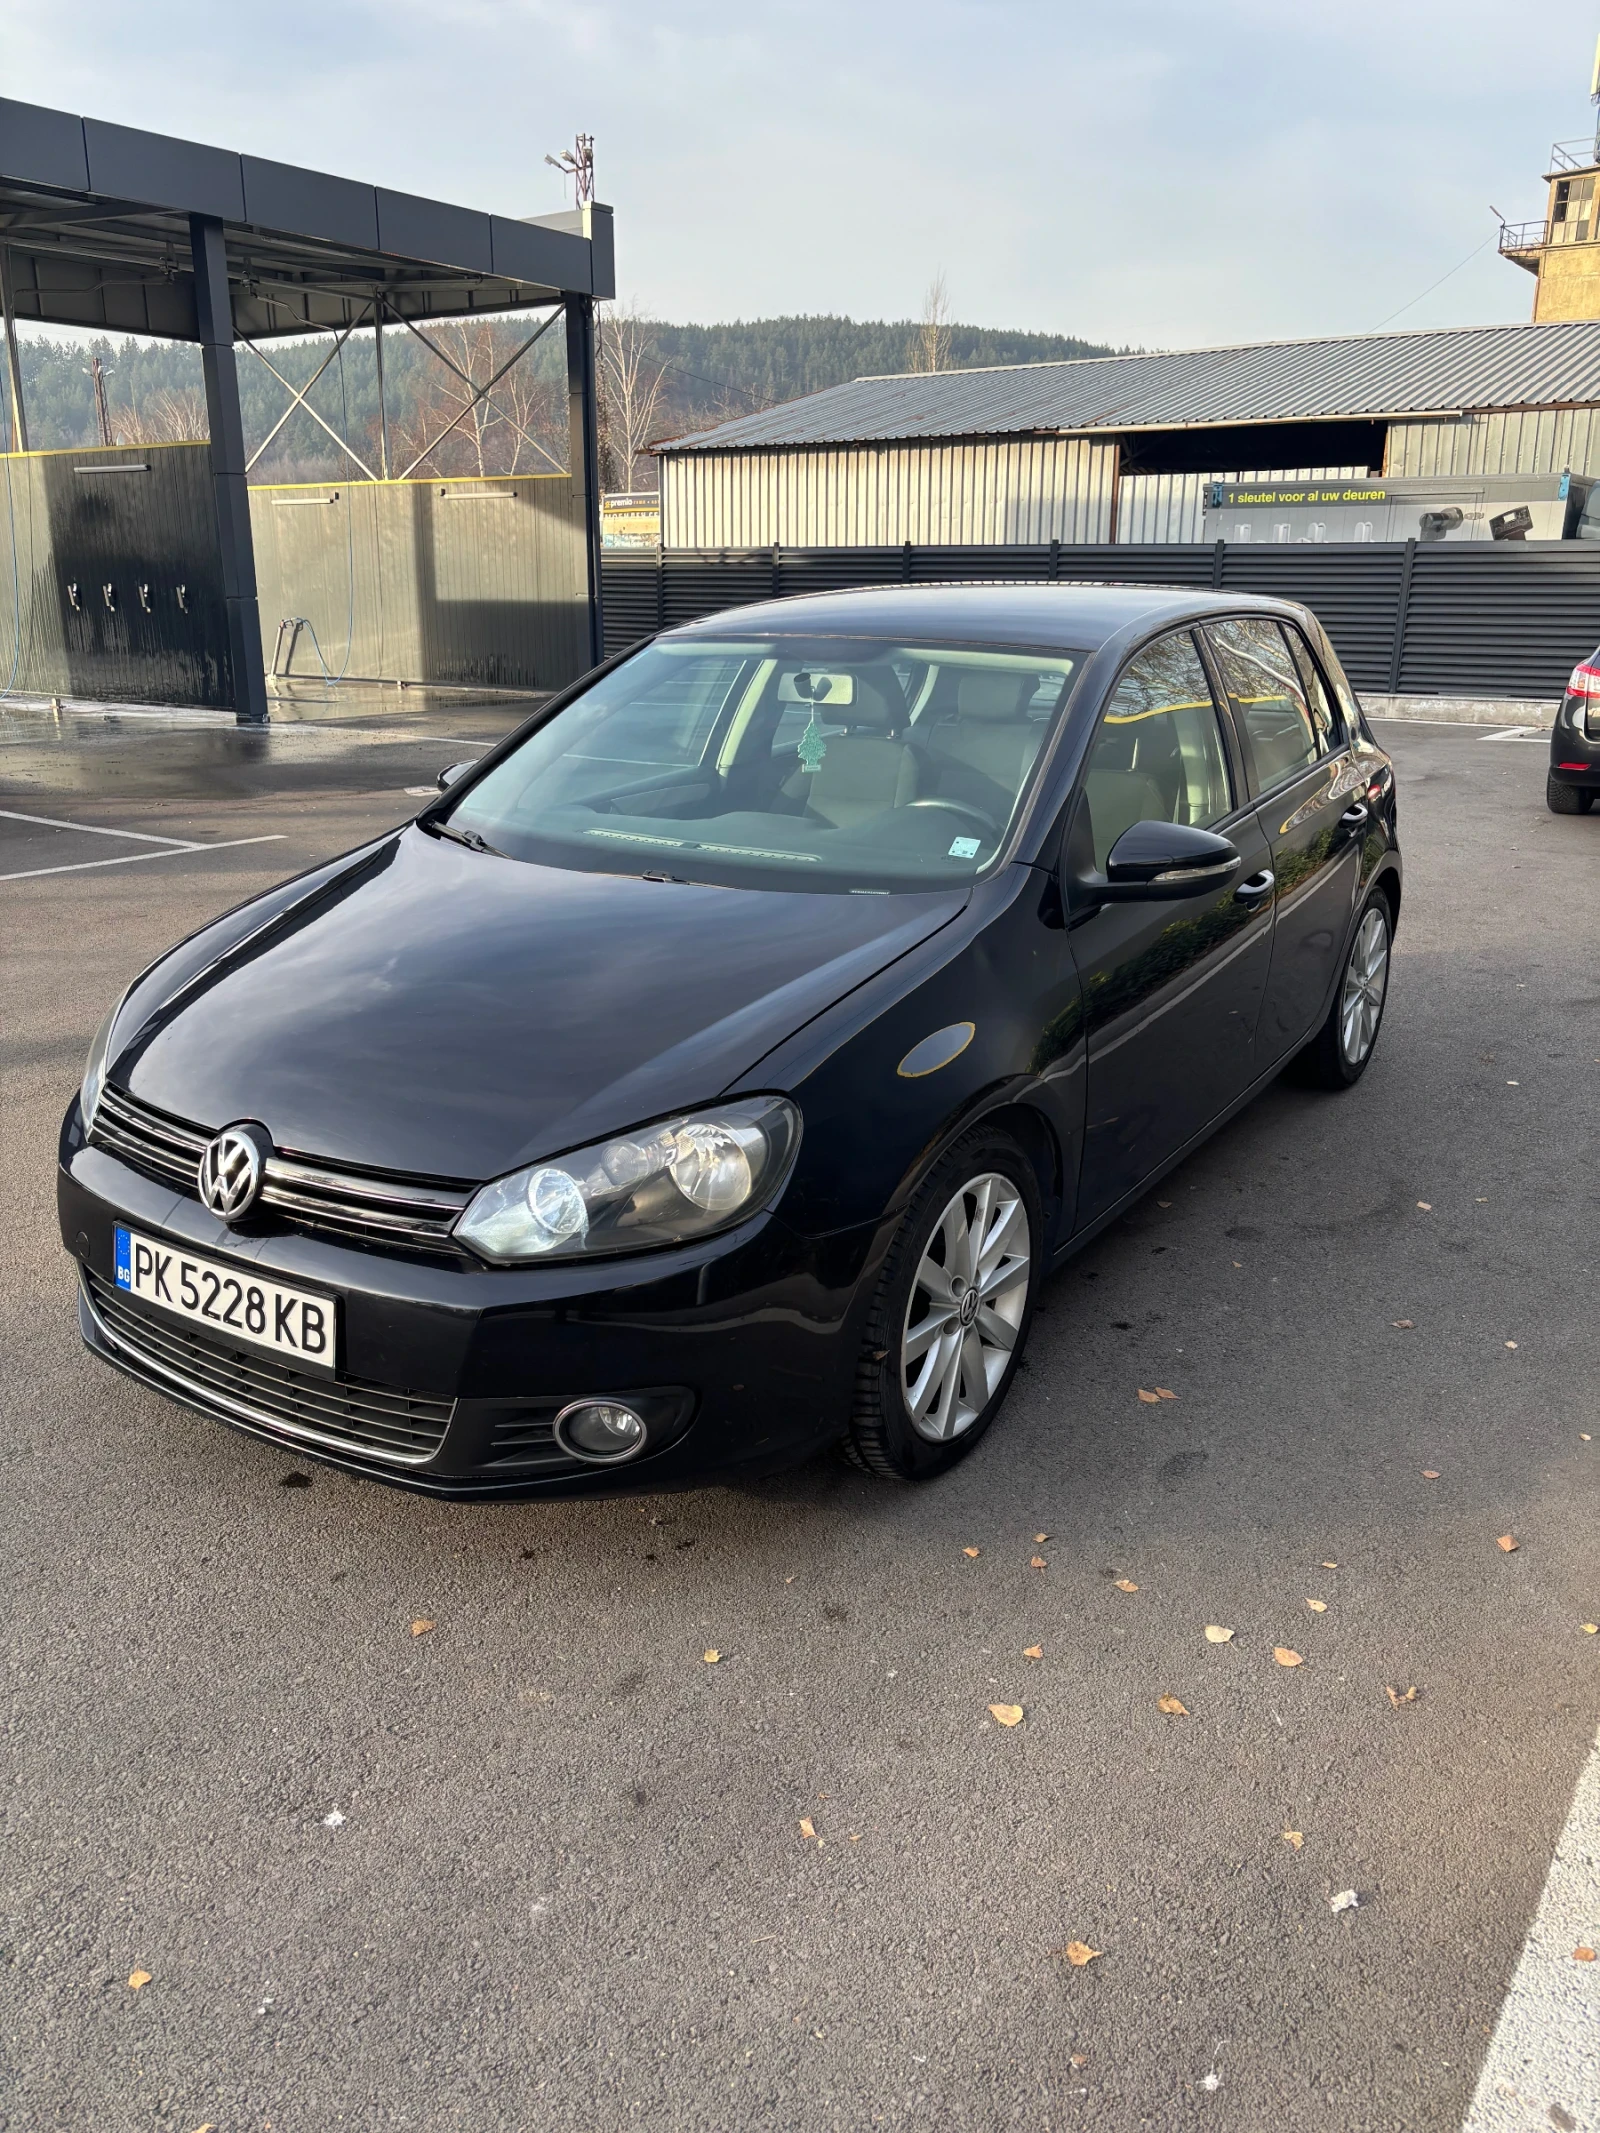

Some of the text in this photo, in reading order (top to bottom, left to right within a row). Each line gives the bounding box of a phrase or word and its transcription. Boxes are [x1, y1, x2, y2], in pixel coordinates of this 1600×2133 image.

[610, 497, 633, 508] premio
[1228, 489, 1386, 503] 1 sleutel voor al uw deuren
[198, 1131, 259, 1221] VW
[117, 1265, 130, 1283] BG
[135, 1242, 326, 1354] PK 5228 KB
